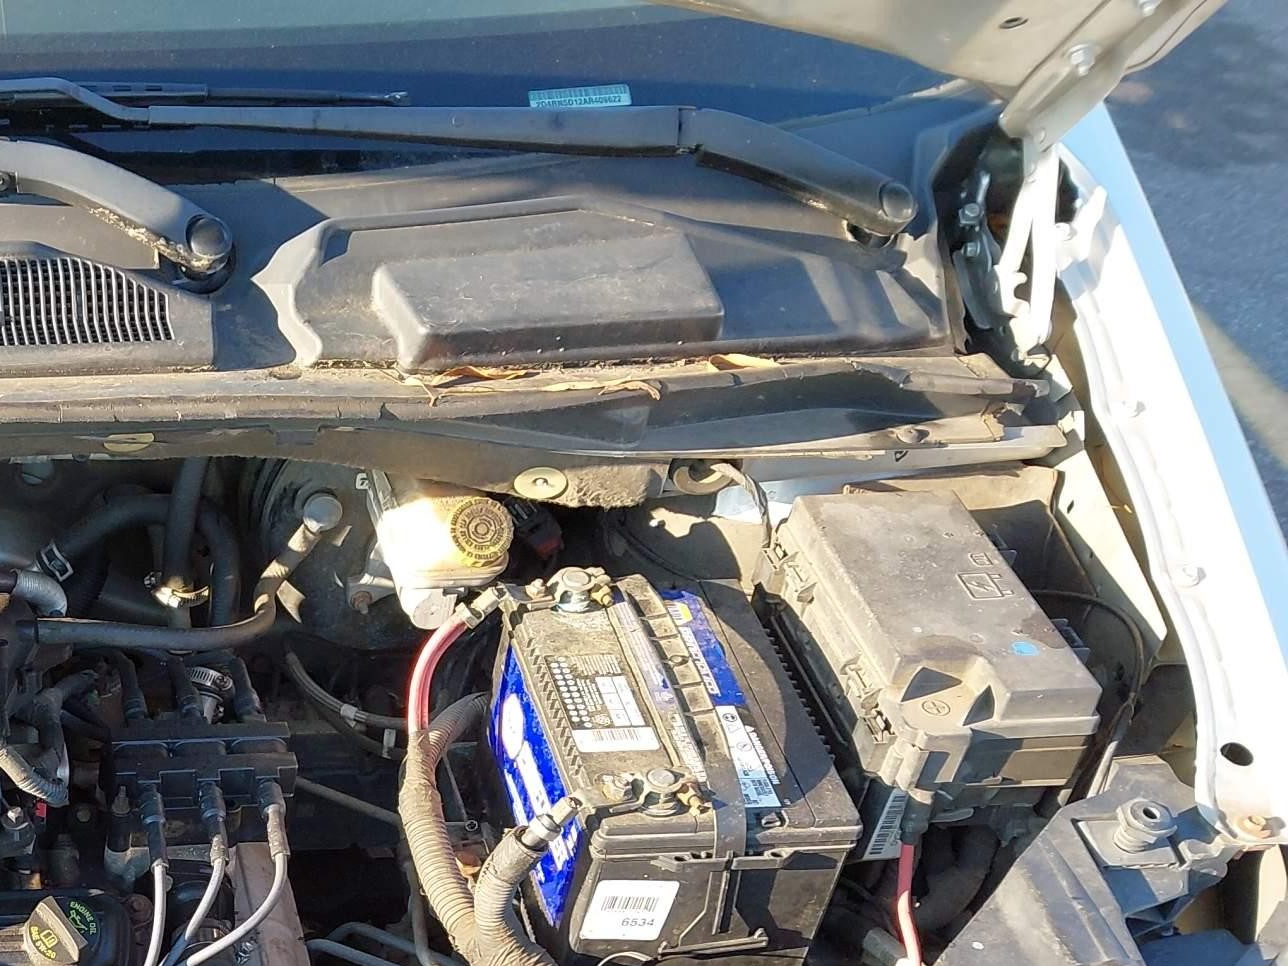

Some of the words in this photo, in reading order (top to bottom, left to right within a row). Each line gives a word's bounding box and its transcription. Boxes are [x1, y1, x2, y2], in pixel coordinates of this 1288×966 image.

[69, 901, 94, 922] ENGINE
[89, 922, 97, 935] OIL
[621, 916, 655, 928] 6534
[30, 926, 40, 941] SAE
[35, 939, 57, 959] 5W-20
